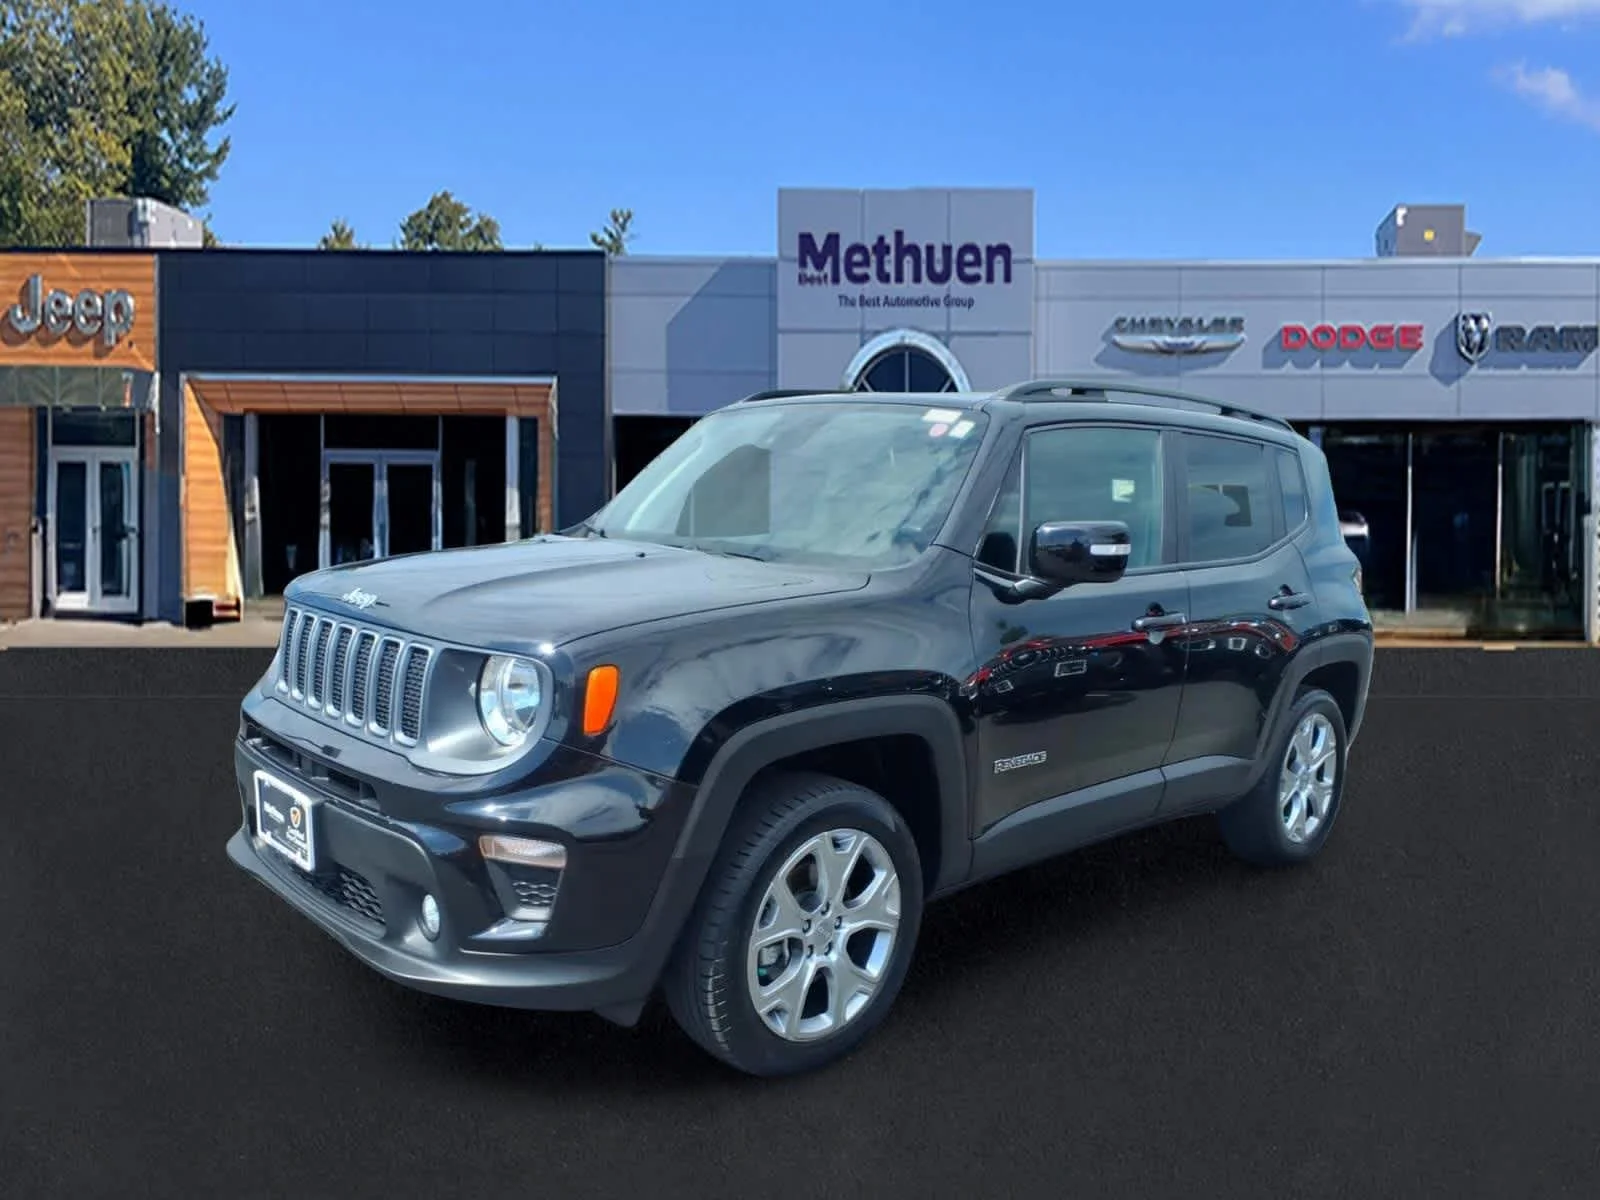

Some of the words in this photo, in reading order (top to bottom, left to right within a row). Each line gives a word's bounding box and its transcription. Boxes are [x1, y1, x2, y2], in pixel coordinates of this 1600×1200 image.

[798, 230, 1012, 285] Methuen
[798, 273, 828, 286] Best
[9, 274, 135, 346] Jeep
[838, 295, 857, 307] The
[859, 295, 880, 307] Best
[883, 294, 941, 308] Automotive
[944, 295, 974, 310] Group
[1114, 317, 1244, 334] CHRYSLER
[1281, 323, 1424, 351] DODGE
[1495, 325, 1598, 352] RAM
[342, 587, 377, 610] Jeep
[993, 751, 1047, 774] RENEGADE
